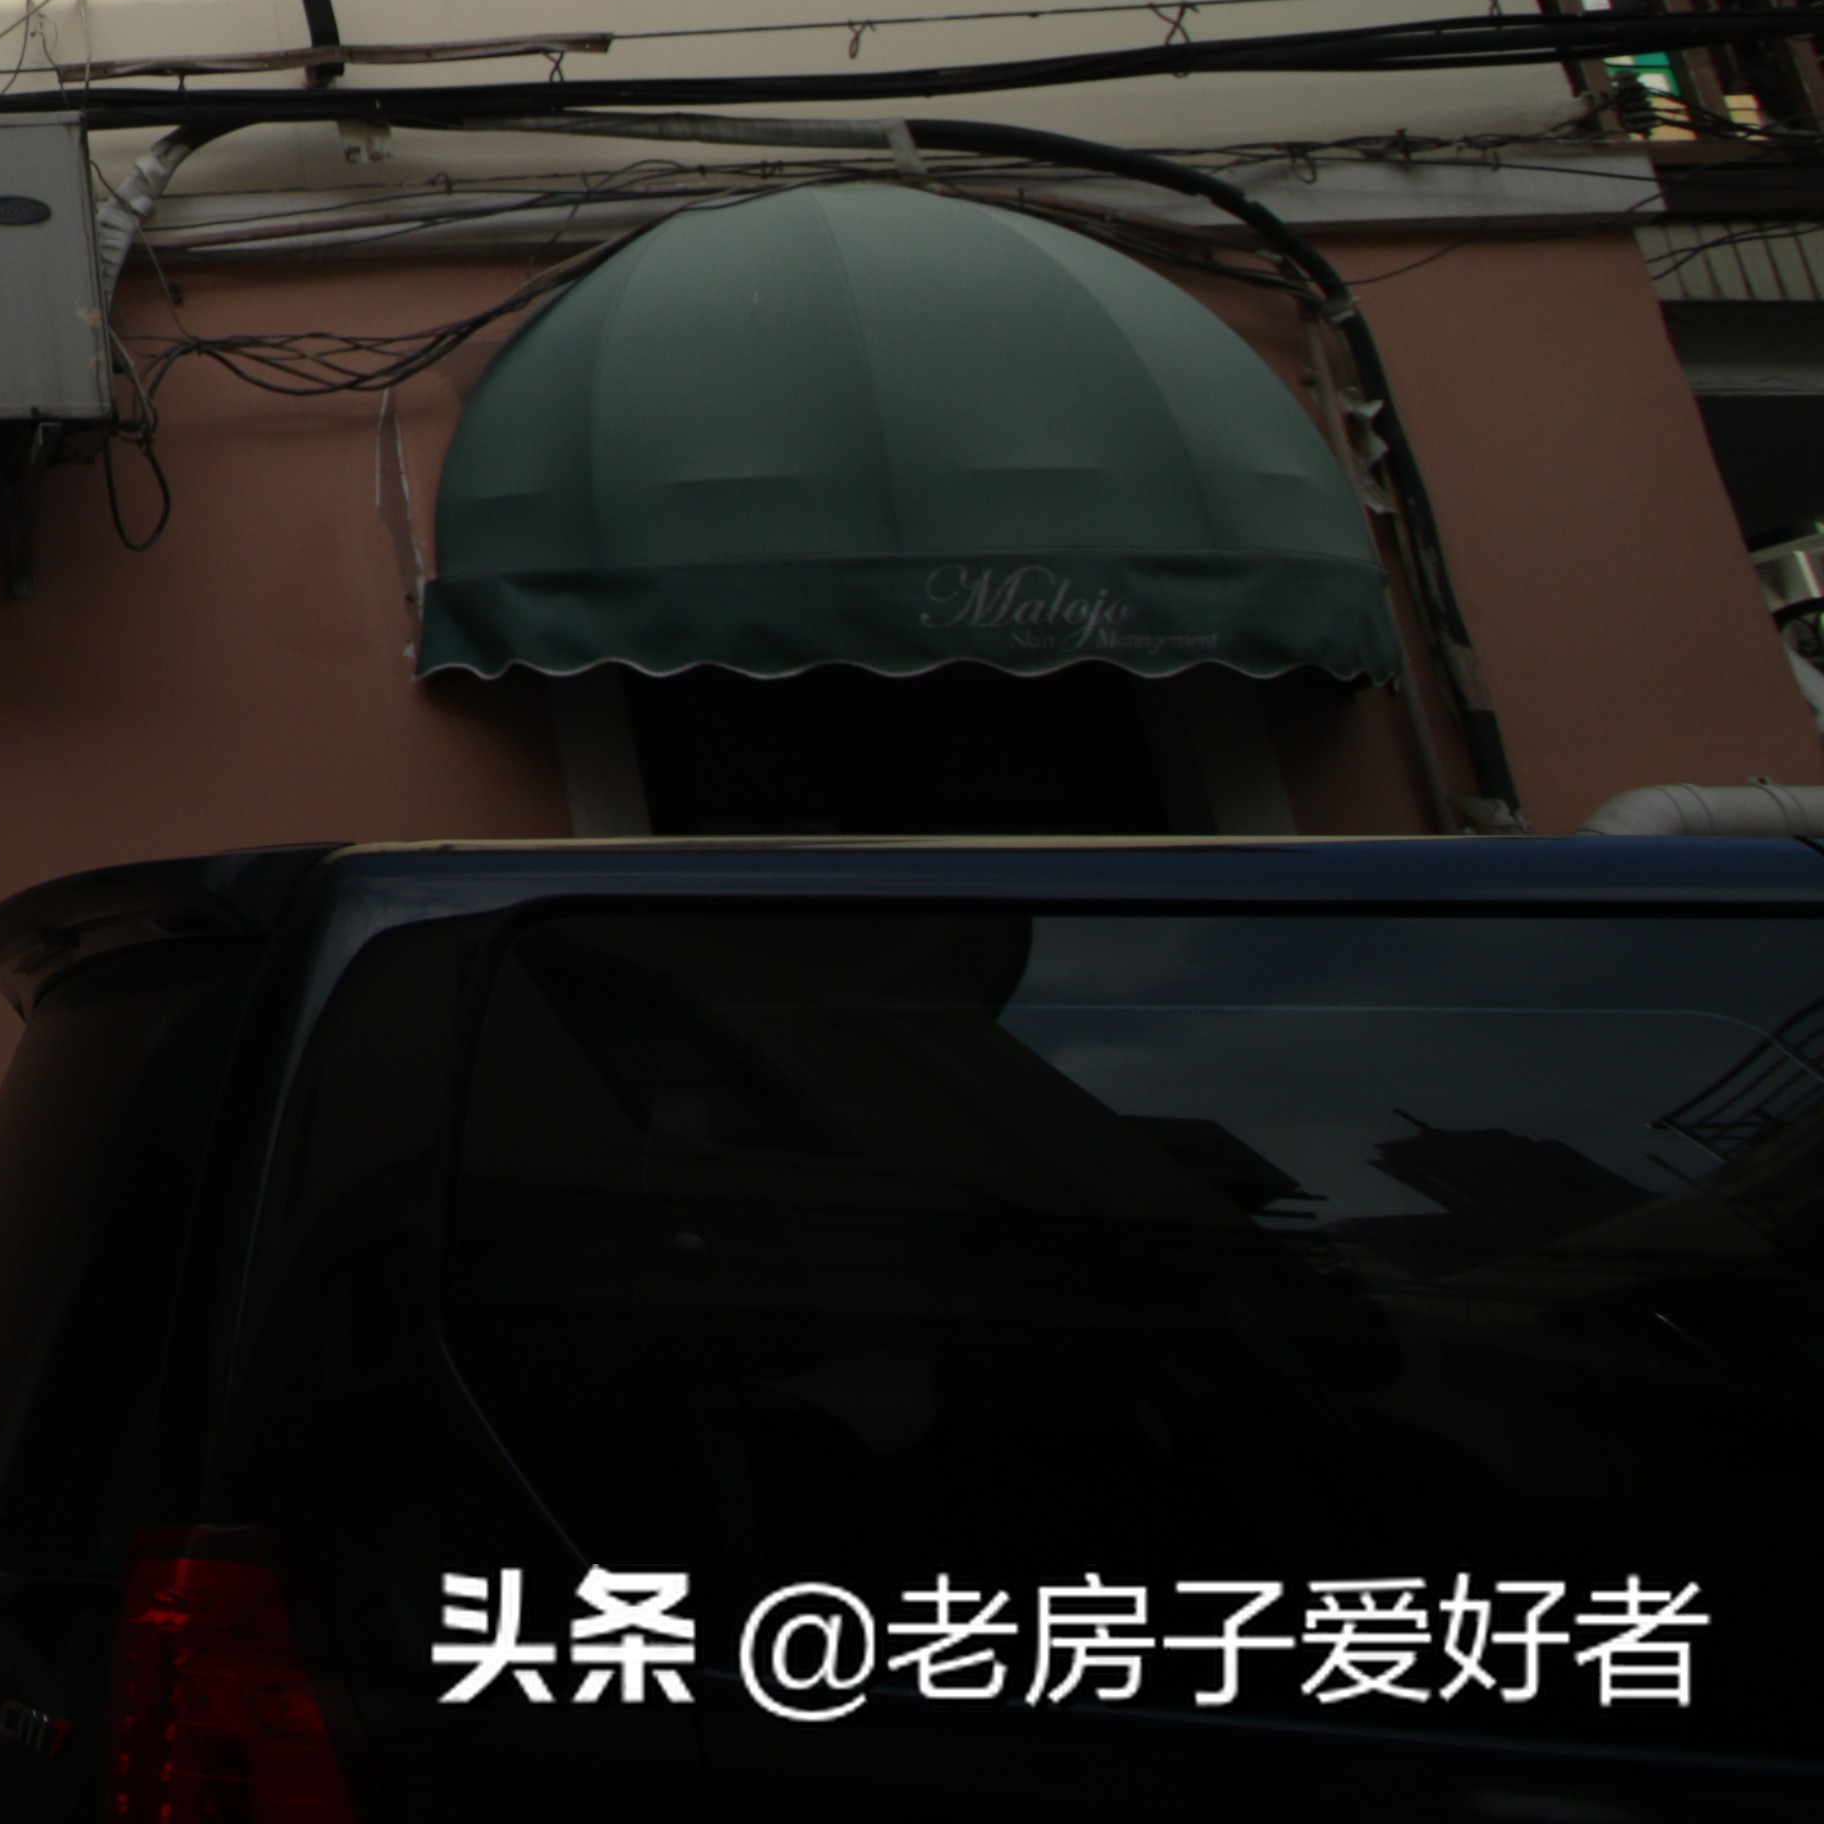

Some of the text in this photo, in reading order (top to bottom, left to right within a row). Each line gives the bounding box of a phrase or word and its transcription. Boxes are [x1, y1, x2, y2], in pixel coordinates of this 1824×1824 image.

[919, 564, 1135, 652] Malojo
[1010, 628, 1219, 654] Skin Management
